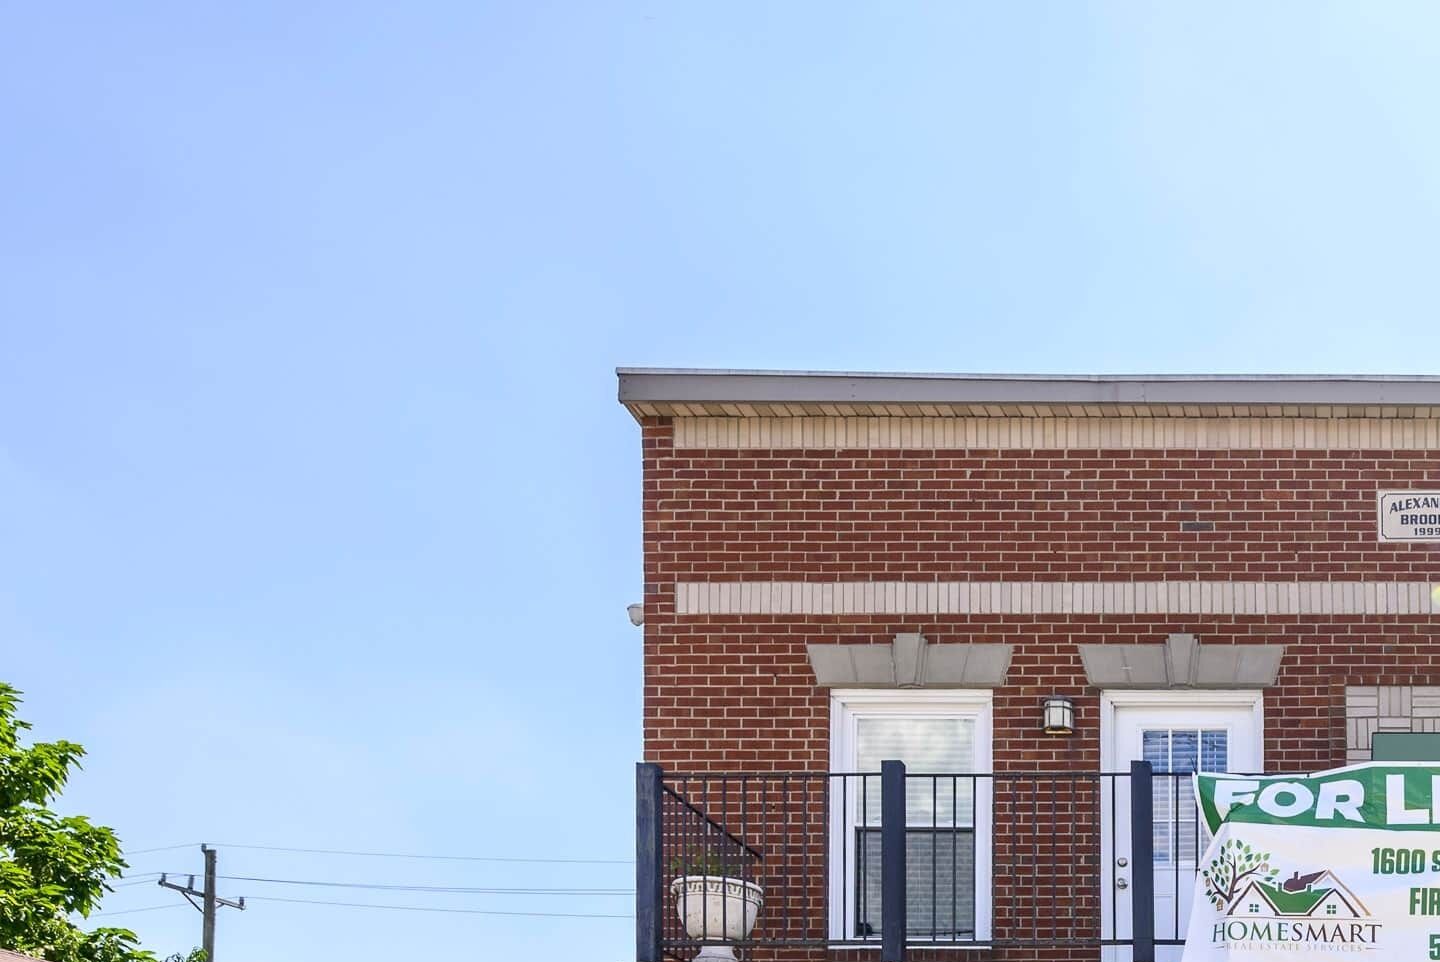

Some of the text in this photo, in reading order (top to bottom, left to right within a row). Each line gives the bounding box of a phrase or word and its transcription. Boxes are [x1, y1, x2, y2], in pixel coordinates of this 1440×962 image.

[1414, 527, 1440, 536] 1999
[1214, 779, 1365, 823] FOR
[1371, 847, 1426, 874] 1600
[1212, 921, 1383, 943] HOMESMART
[1259, 943, 1301, 951] ESTATE
[1306, 943, 1363, 952] SERVICES
